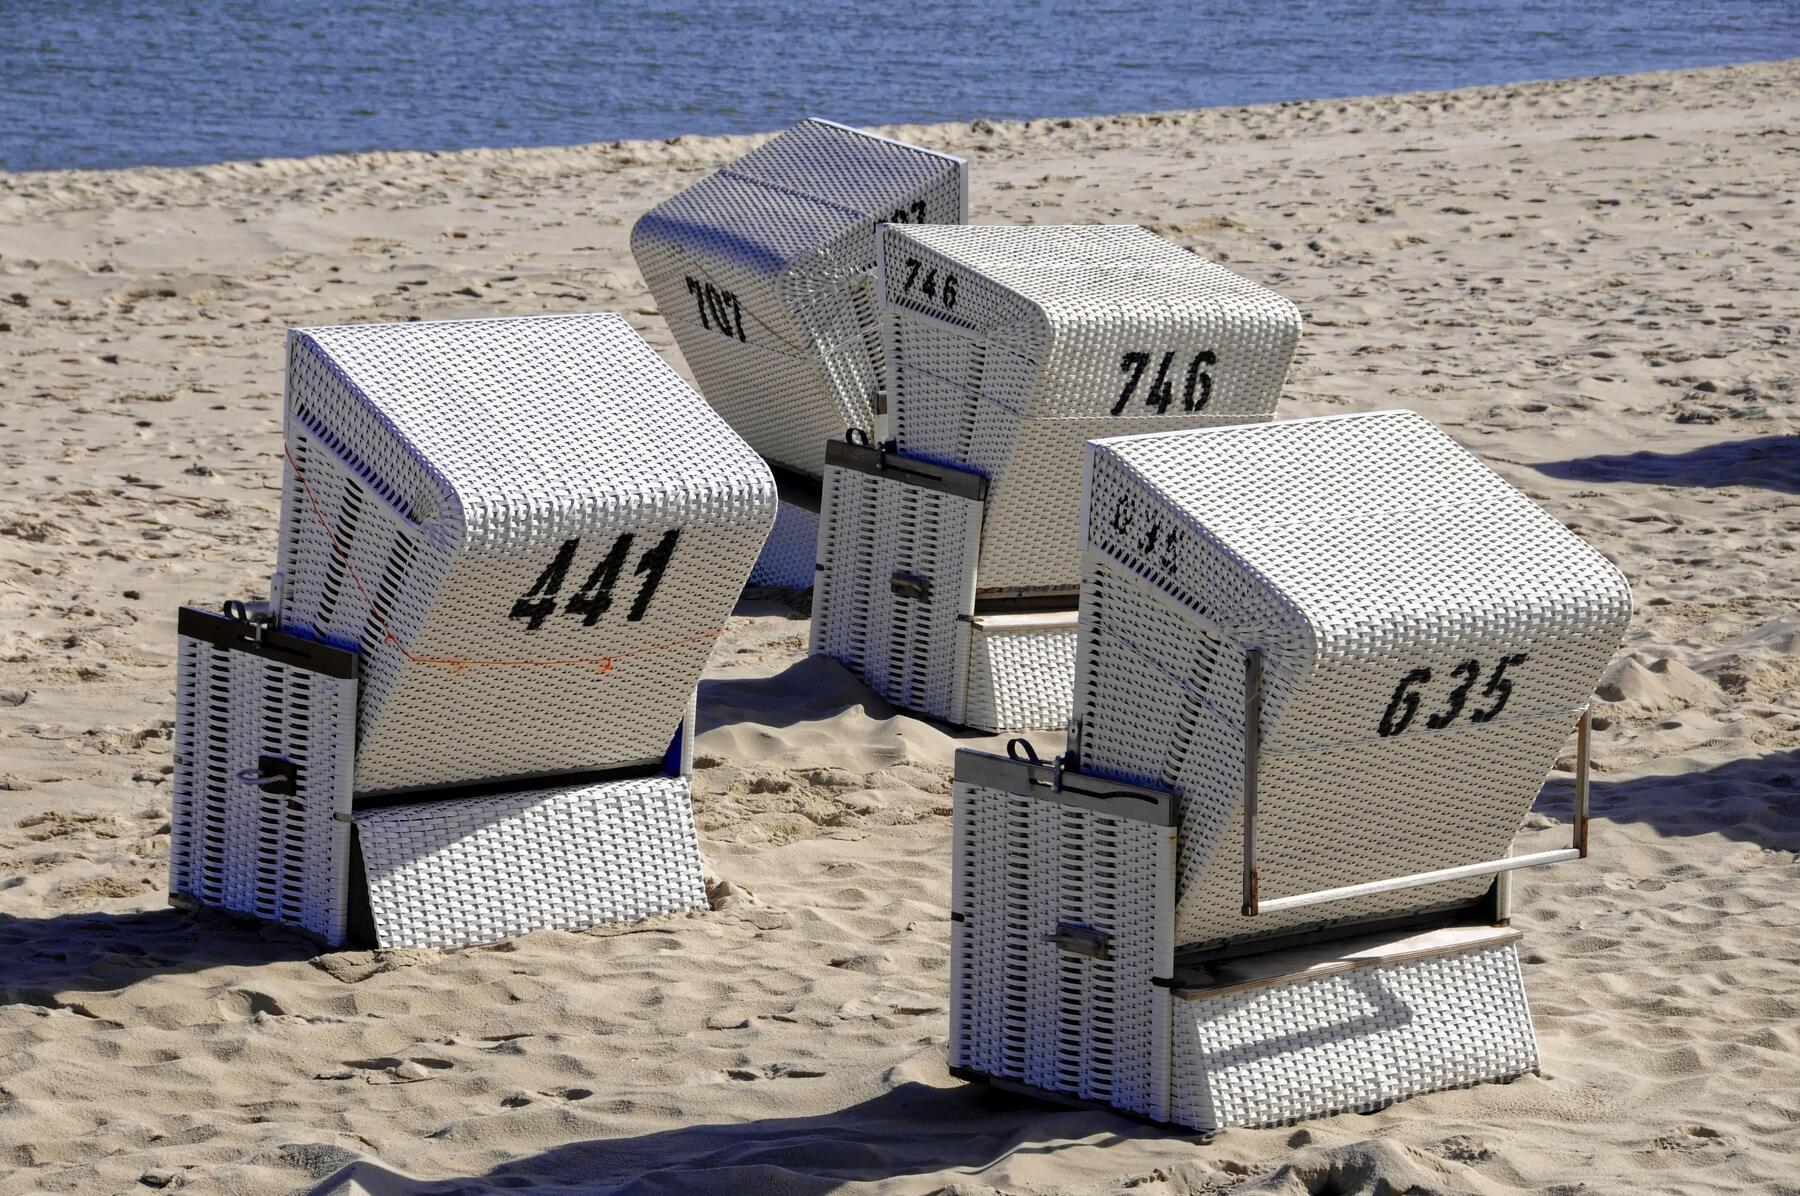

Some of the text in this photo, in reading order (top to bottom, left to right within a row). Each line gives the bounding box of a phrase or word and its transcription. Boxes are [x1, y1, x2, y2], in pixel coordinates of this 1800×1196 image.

[685, 276, 747, 343] 707
[904, 257, 958, 309] 746
[1111, 350, 1216, 416] 746
[508, 530, 680, 630] 441
[1377, 653, 1528, 737] 635
